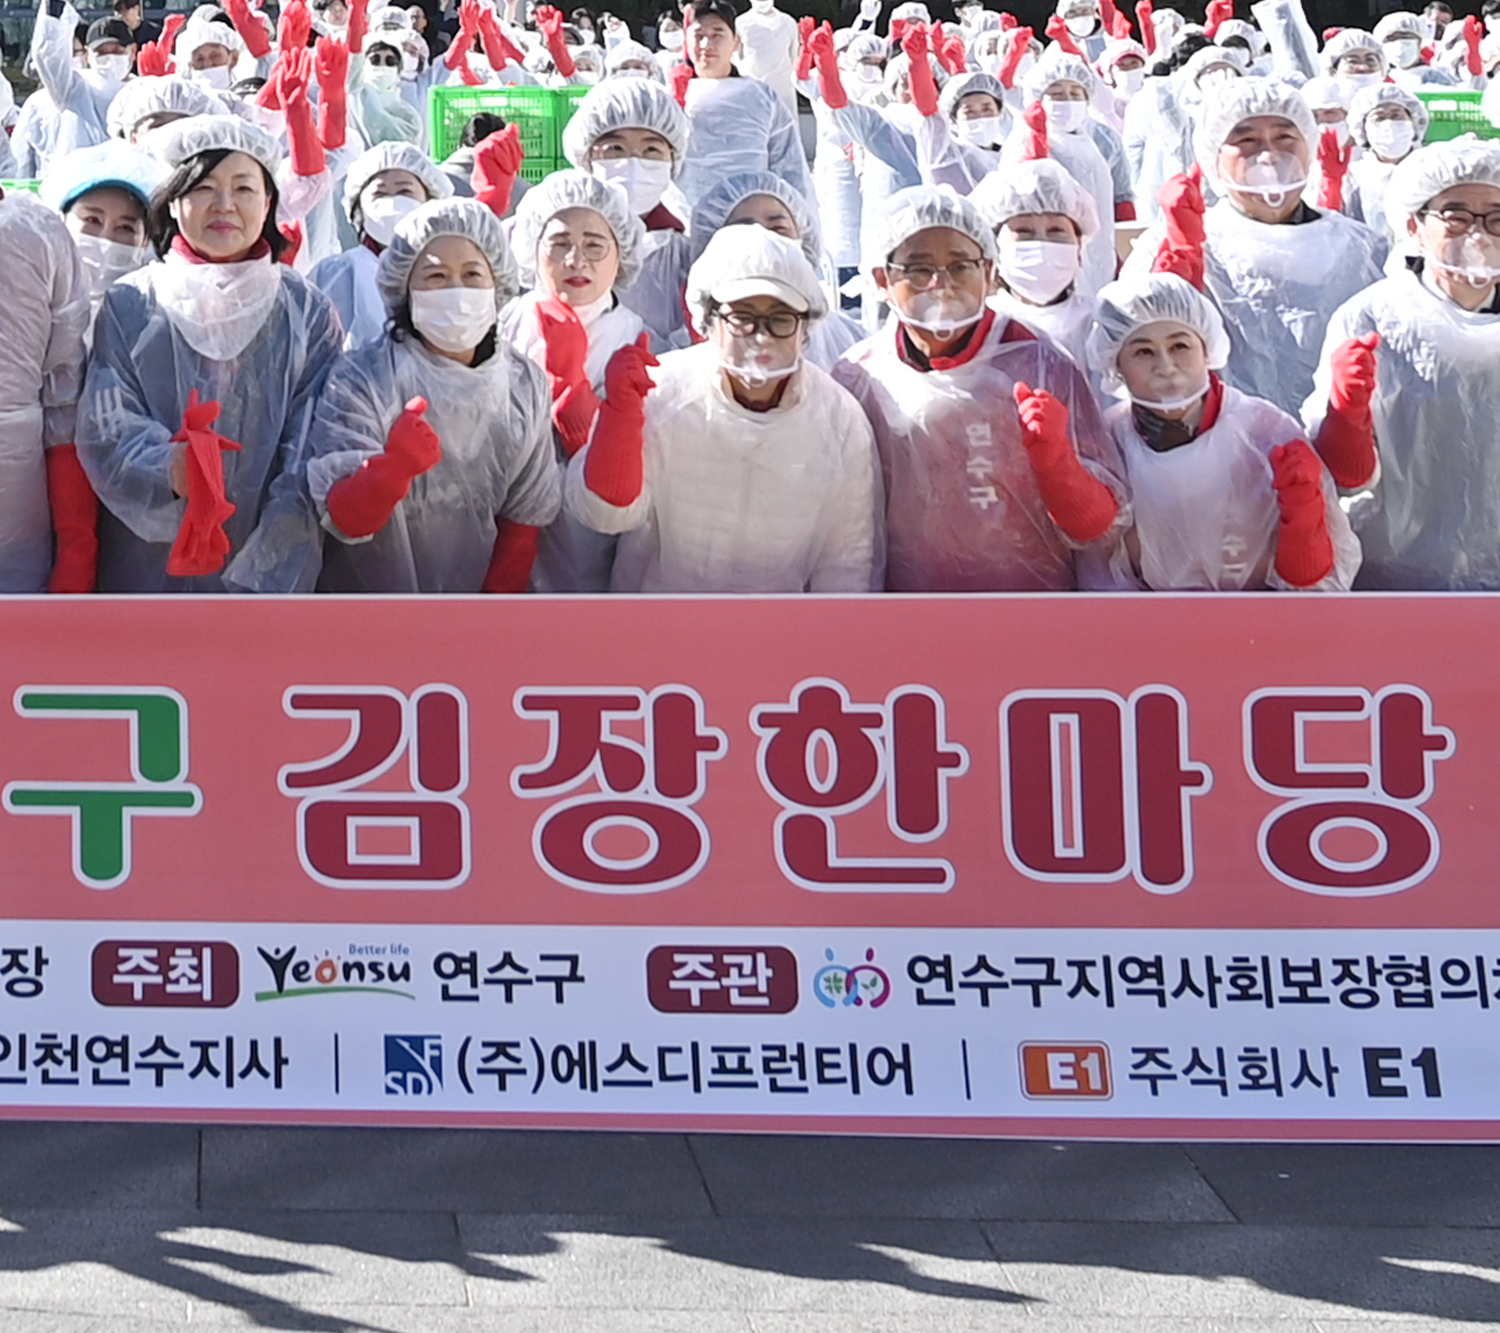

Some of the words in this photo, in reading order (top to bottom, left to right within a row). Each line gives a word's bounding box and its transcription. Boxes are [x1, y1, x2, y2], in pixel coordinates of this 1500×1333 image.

[964, 421, 999, 511] 연수구
[277, 678, 1456, 896] 김장한마당
[115, 945, 215, 1003] 주최
[256, 945, 411, 995] Yeonsu
[433, 951, 585, 1004] 연수구
[348, 943, 387, 955] Better
[389, 943, 410, 955] life
[669, 949, 776, 1010] 주관
[457, 1035, 914, 1095] (주)에스디프런티어
[1129, 1047, 1339, 1097] 주식회사
[1362, 1047, 1442, 1098] E1
